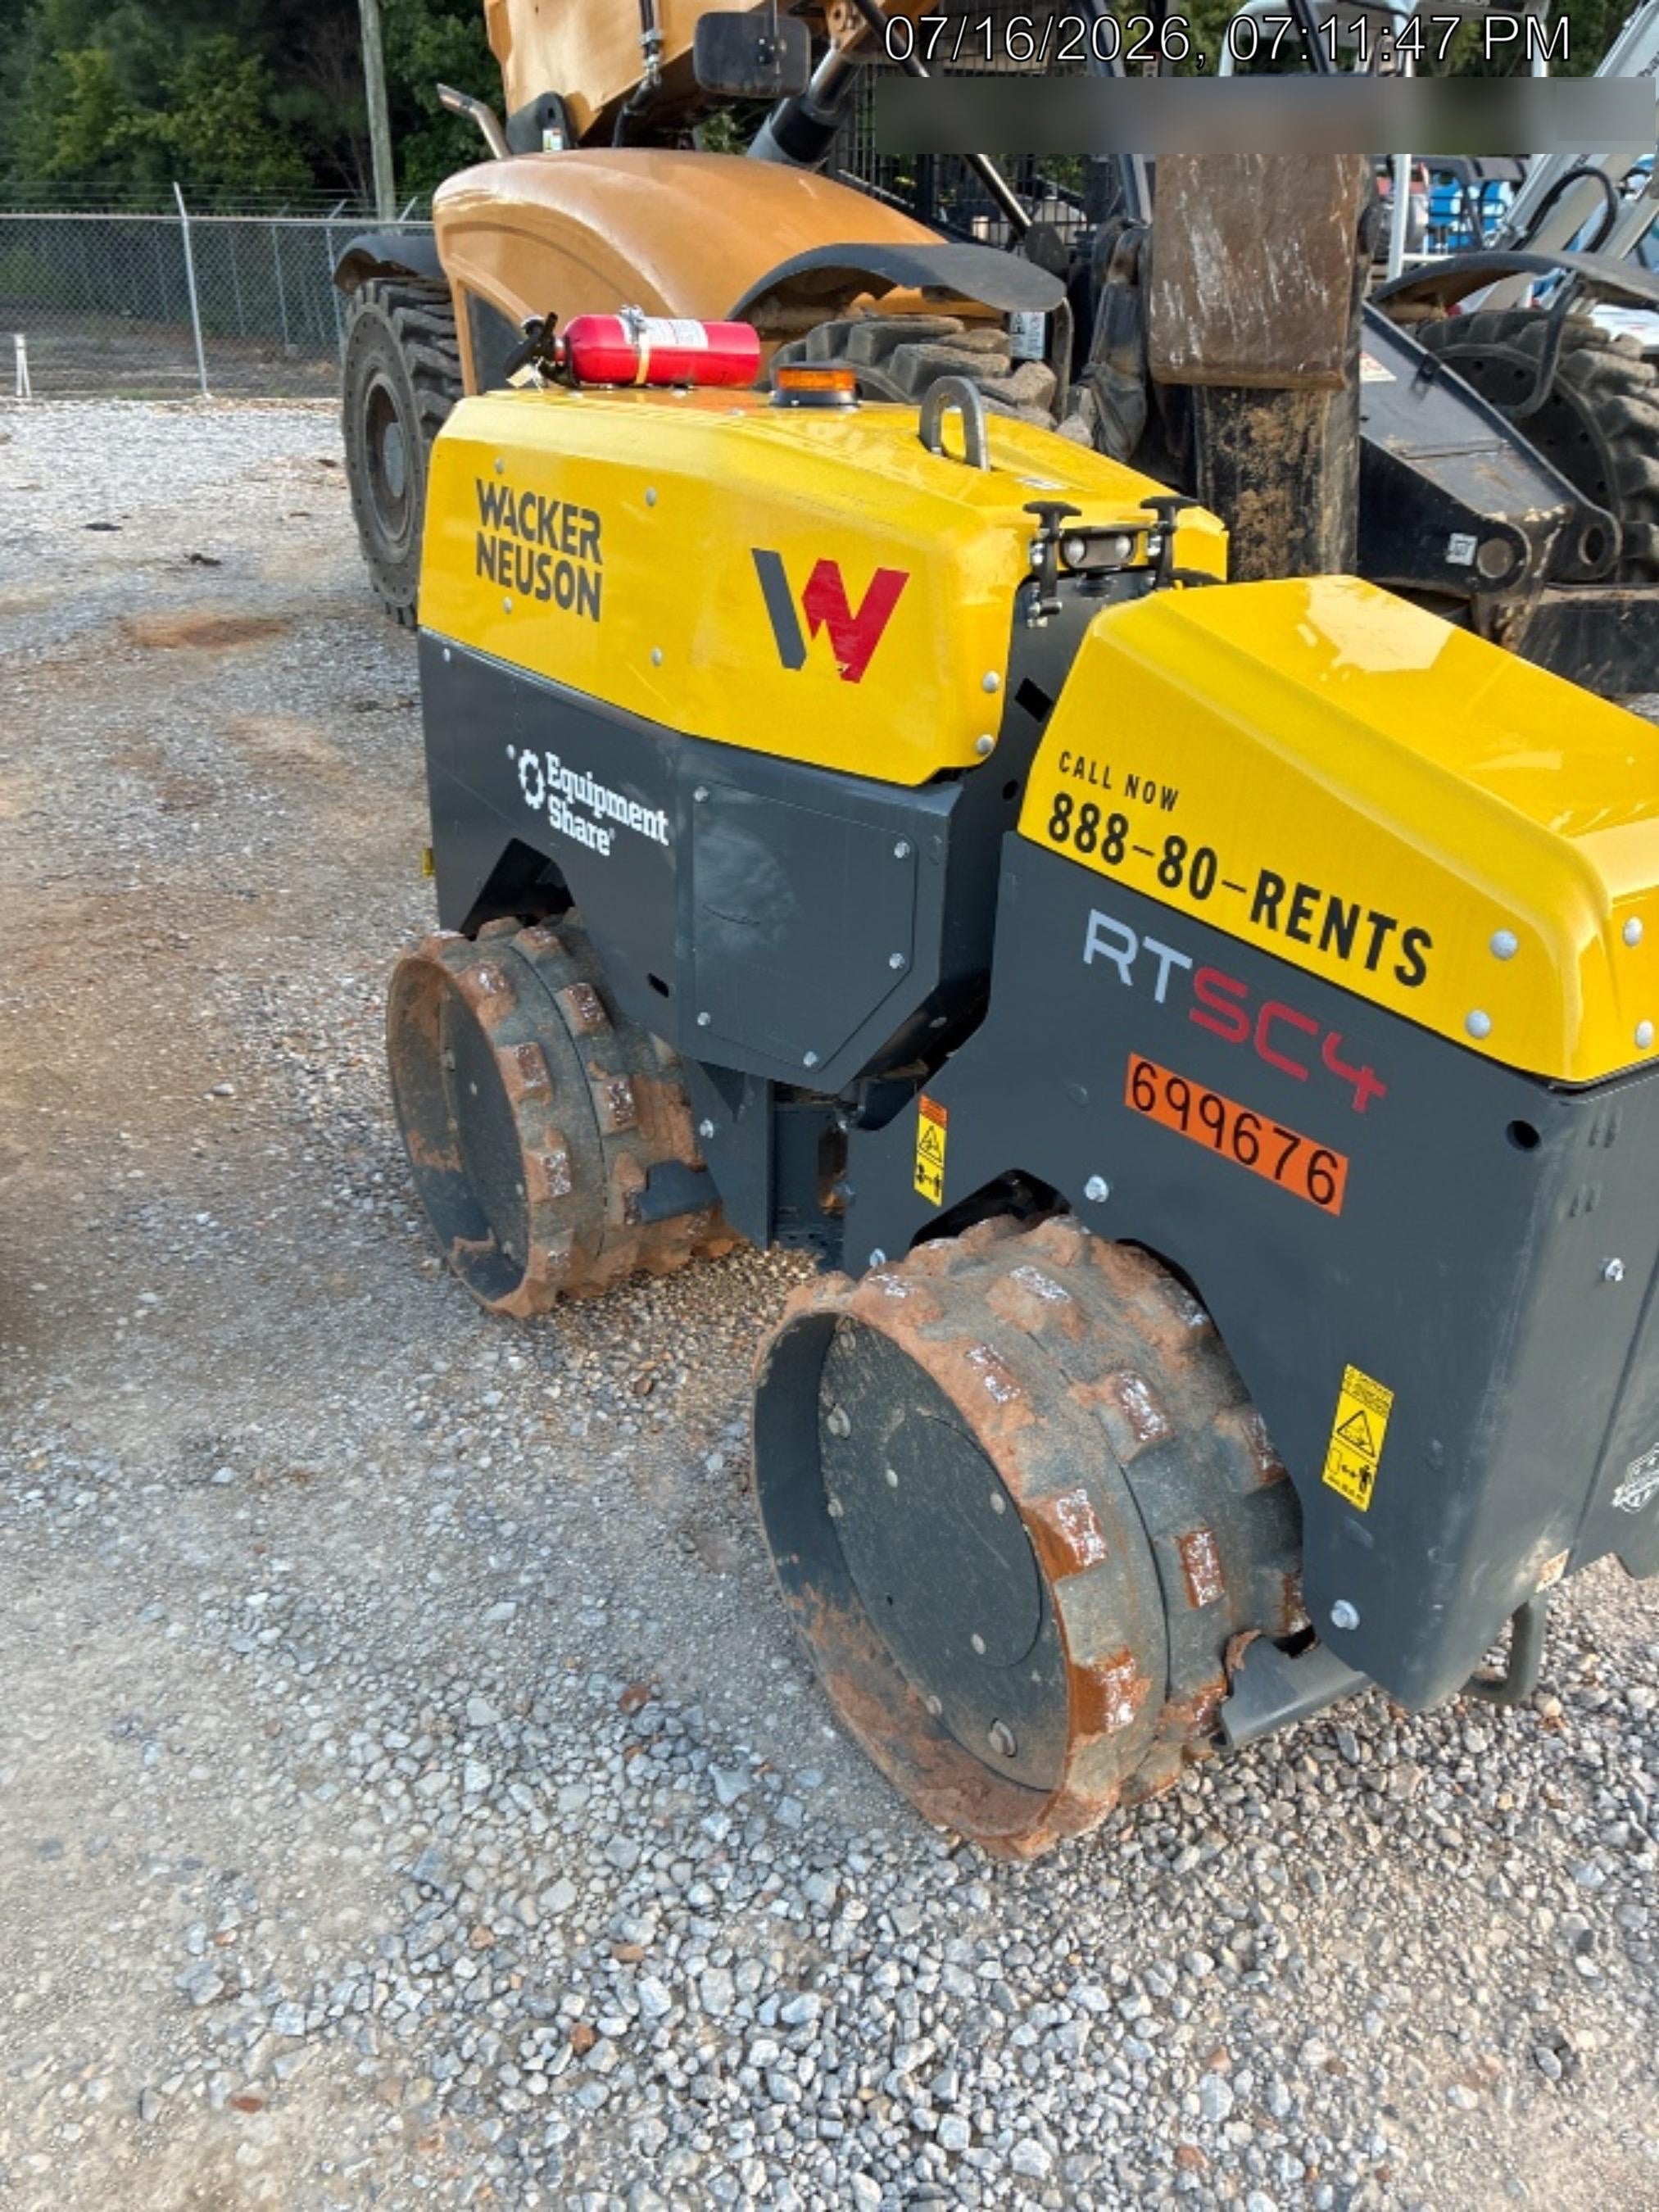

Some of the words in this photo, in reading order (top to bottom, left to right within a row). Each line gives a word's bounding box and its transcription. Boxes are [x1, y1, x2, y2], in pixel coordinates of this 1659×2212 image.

[475, 478, 603, 565] WACKER
[476, 531, 603, 623] NEUSON
[545, 751, 669, 846] Equipment
[1058, 751, 1113, 790] CALL
[1125, 773, 1179, 812] NOW
[1048, 791, 1433, 987] 888-80-RENTS
[1083, 909, 1387, 1113] RTSC4
[1132, 1062, 1338, 1205] 699676
